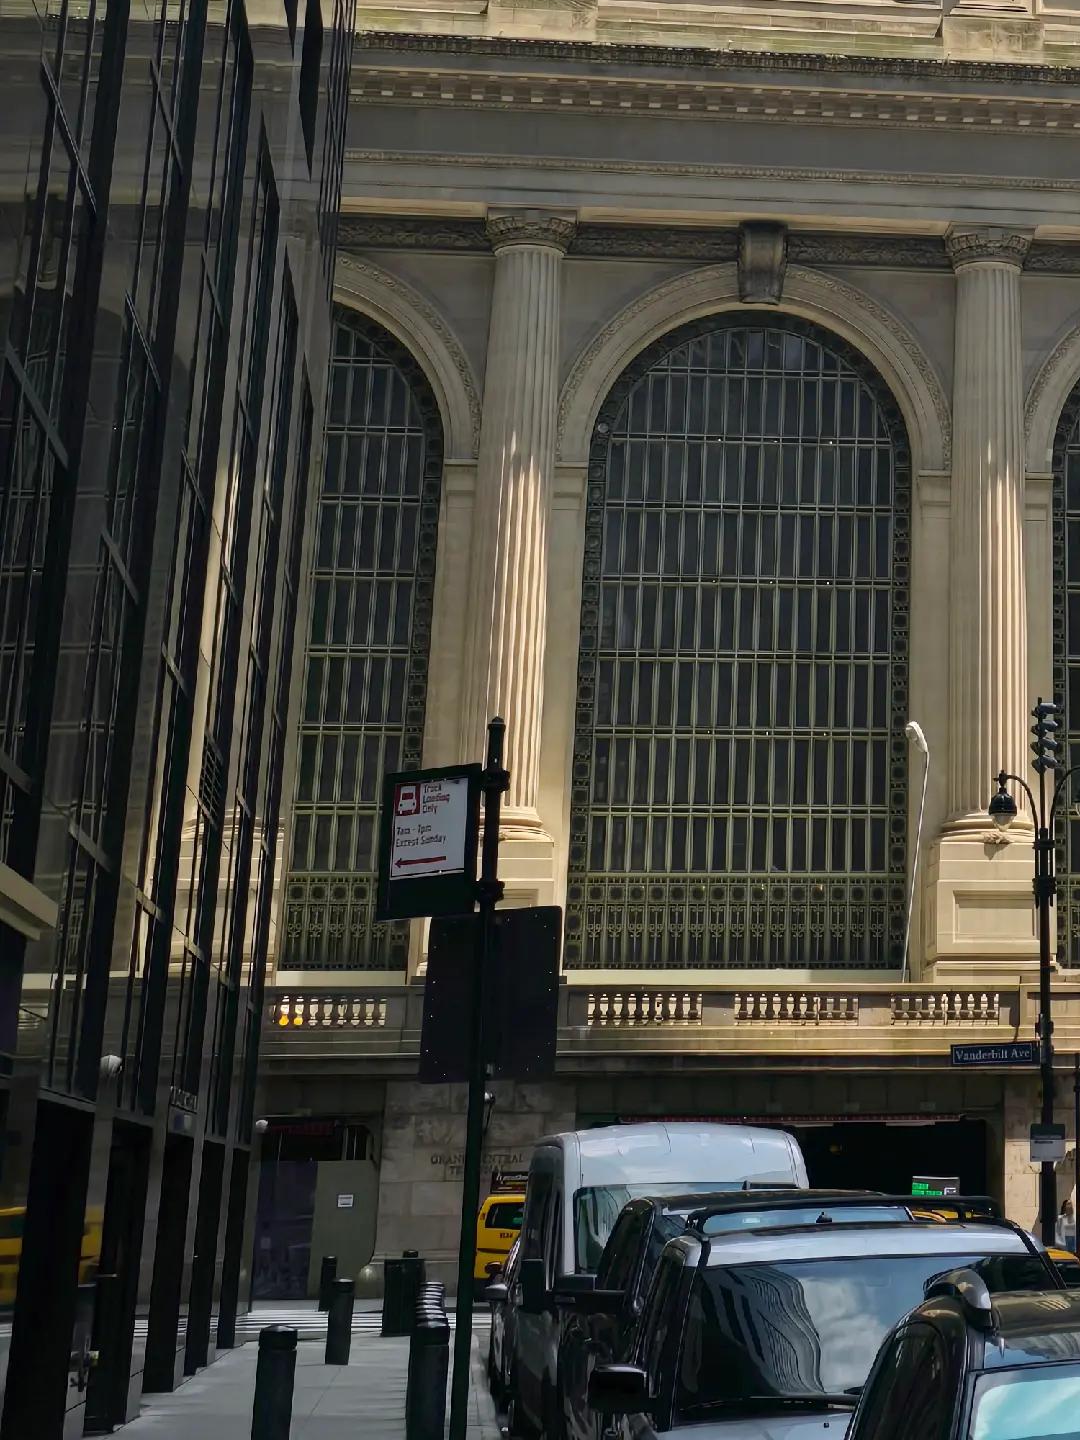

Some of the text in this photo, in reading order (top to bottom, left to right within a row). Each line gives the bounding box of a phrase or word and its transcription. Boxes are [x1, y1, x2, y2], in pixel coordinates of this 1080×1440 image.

[422, 793, 451, 804] Loading
[422, 804, 438, 814] Only
[396, 834, 447, 848] Except Sunday
[955, 1048, 1030, 1061] Vanderbilt Ave
